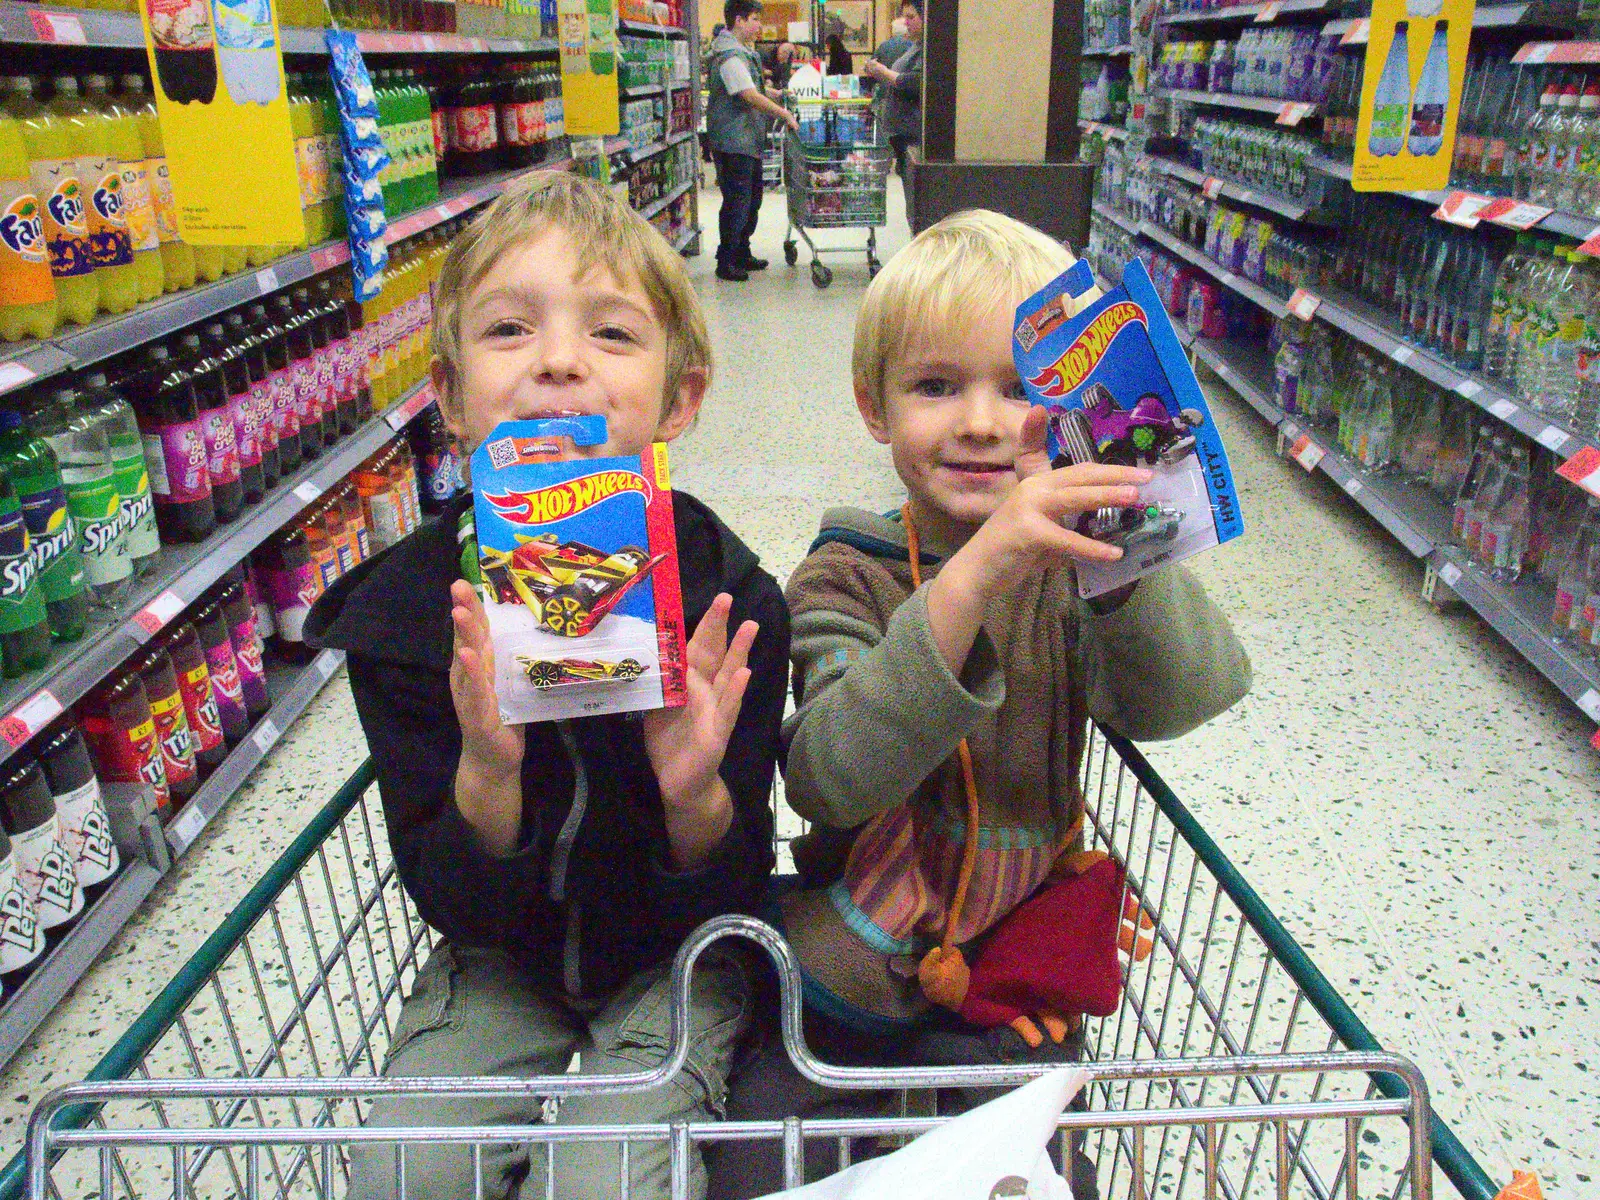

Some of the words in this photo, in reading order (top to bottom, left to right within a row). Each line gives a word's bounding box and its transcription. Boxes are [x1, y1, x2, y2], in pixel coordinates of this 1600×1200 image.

[793, 86, 820, 96] WIN
[48, 194, 83, 226] Fan
[93, 188, 123, 219] Fan
[0, 214, 43, 252] Fan
[1217, 494, 1236, 523] HW
